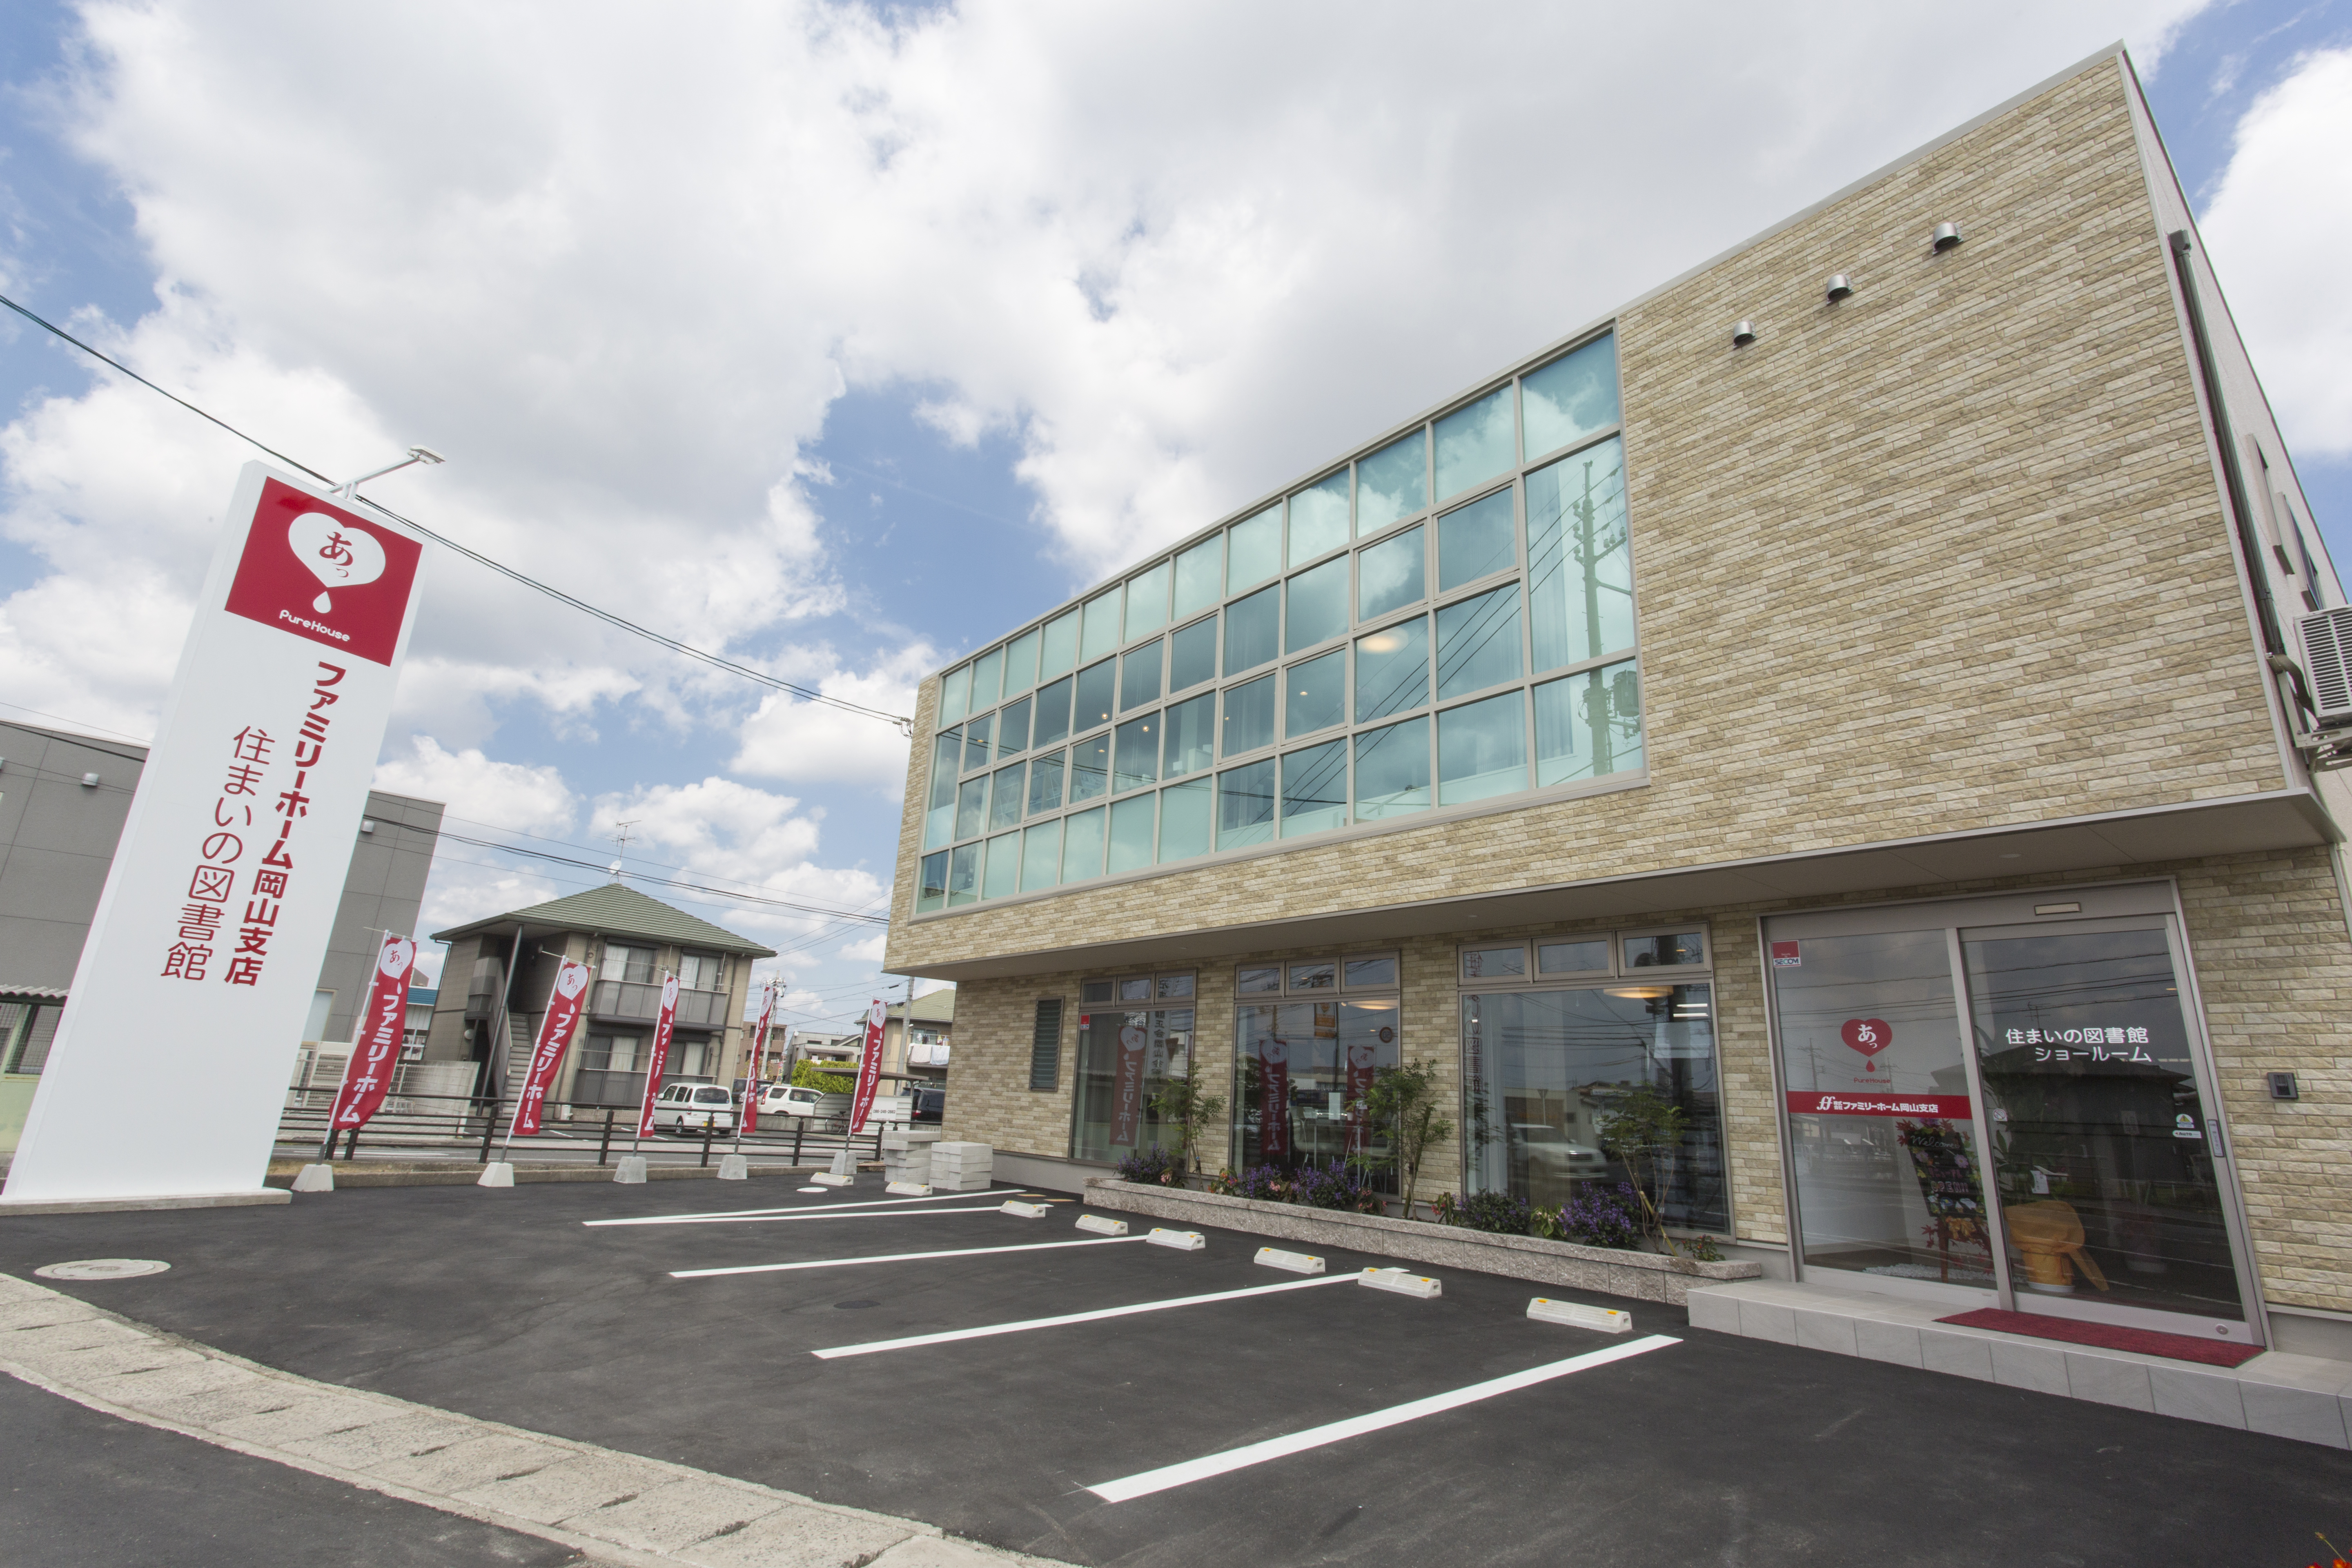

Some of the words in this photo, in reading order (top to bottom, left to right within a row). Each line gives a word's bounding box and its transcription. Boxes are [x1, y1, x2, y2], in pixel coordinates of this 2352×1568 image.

[319, 532, 353, 578] あっ
[279, 609, 350, 641] PureHouse
[224, 661, 346, 986] ファミリーホーム岡山支店
[160, 726, 275, 981] 住まいの図書館
[390, 950, 403, 968] あっ
[339, 995, 399, 1123] ファミリーホーム
[1858, 1024, 1878, 1048] あっ
[2005, 1027, 2149, 1045] 住まいの図書館
[2035, 1046, 2152, 1062] ショールーム
[523, 1013, 572, 1129] ファミリーホーム
[853, 1039, 881, 1129] ファミリーホーム
